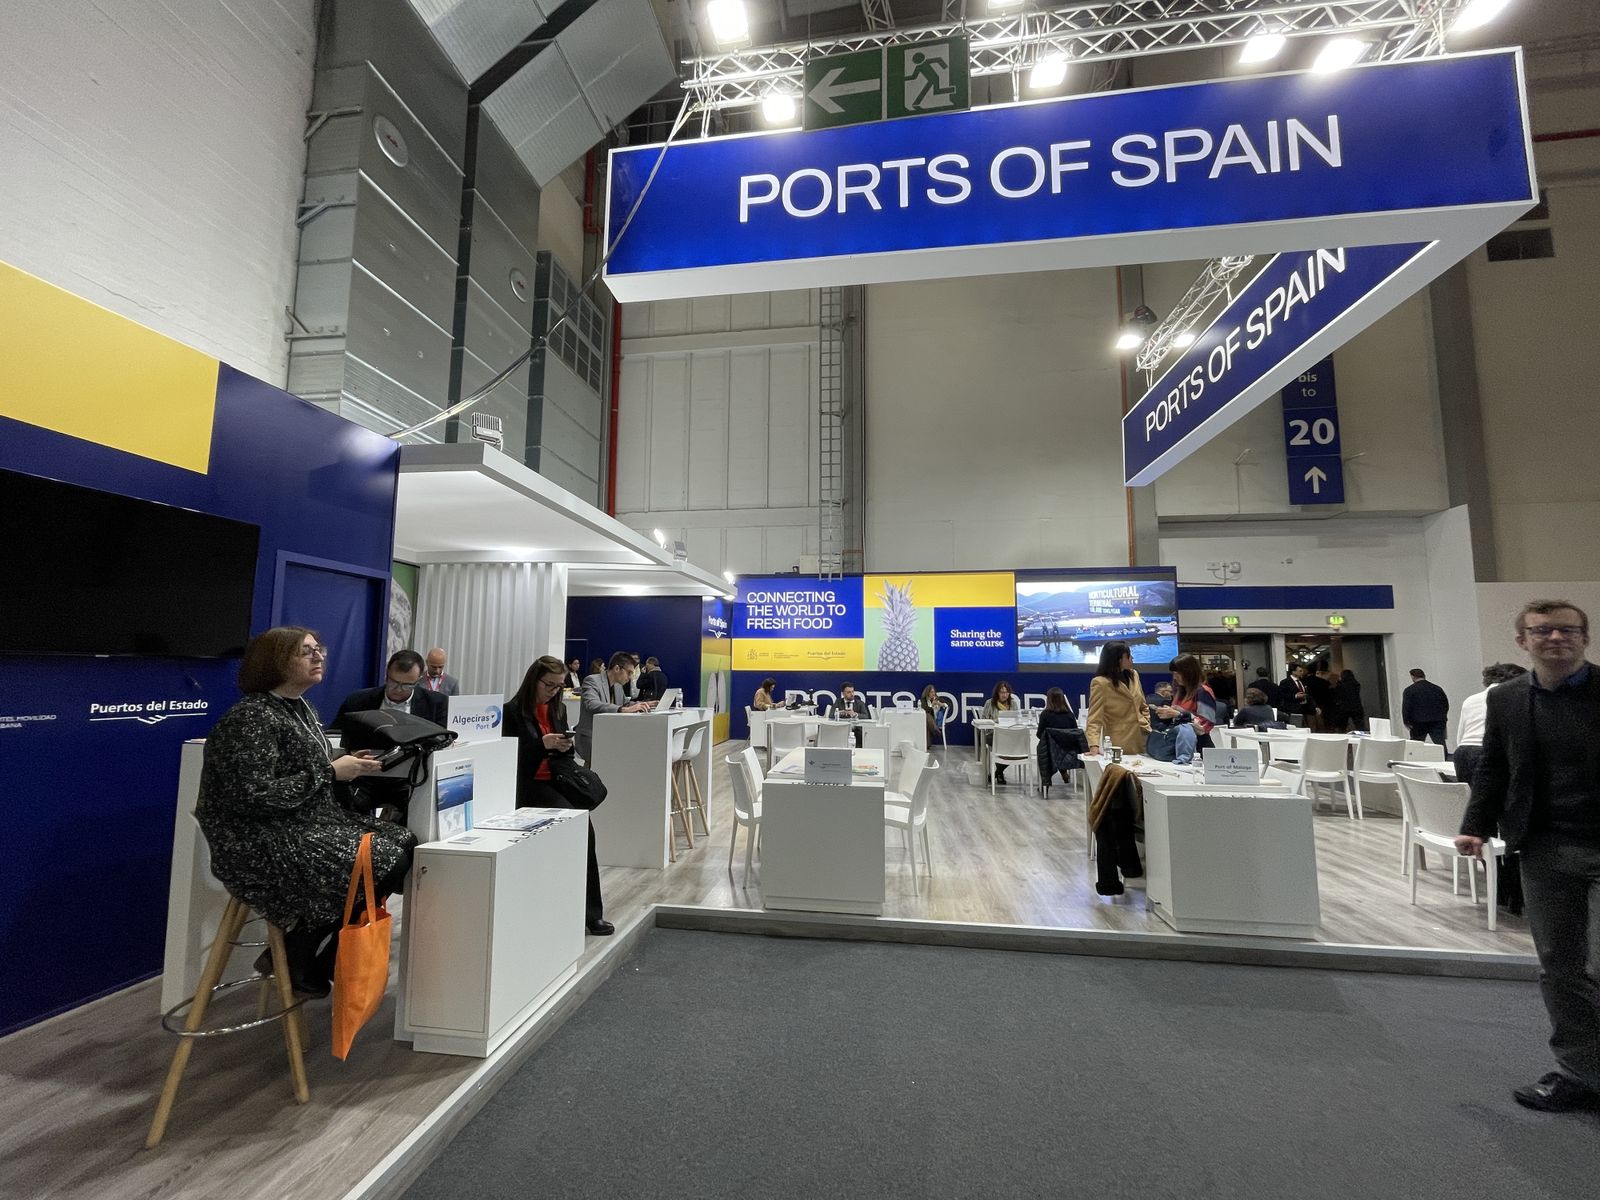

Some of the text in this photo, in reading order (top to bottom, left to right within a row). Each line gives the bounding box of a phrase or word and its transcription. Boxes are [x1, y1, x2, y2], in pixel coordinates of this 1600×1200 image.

[739, 114, 1342, 224] PORTS OF SPAIN
[1145, 247, 1346, 442] PORTS OF SPAIN
[1302, 387, 1317, 397] to
[1289, 418, 1336, 446] 20
[746, 591, 836, 604] CONNECTING
[746, 604, 847, 617] THE WORLD TO
[746, 617, 833, 630] FRESH FOOD
[950, 629, 1002, 640] Sharing the
[90, 699, 209, 714] Puertos del Estado
[452, 714, 490, 725] Algeciras
